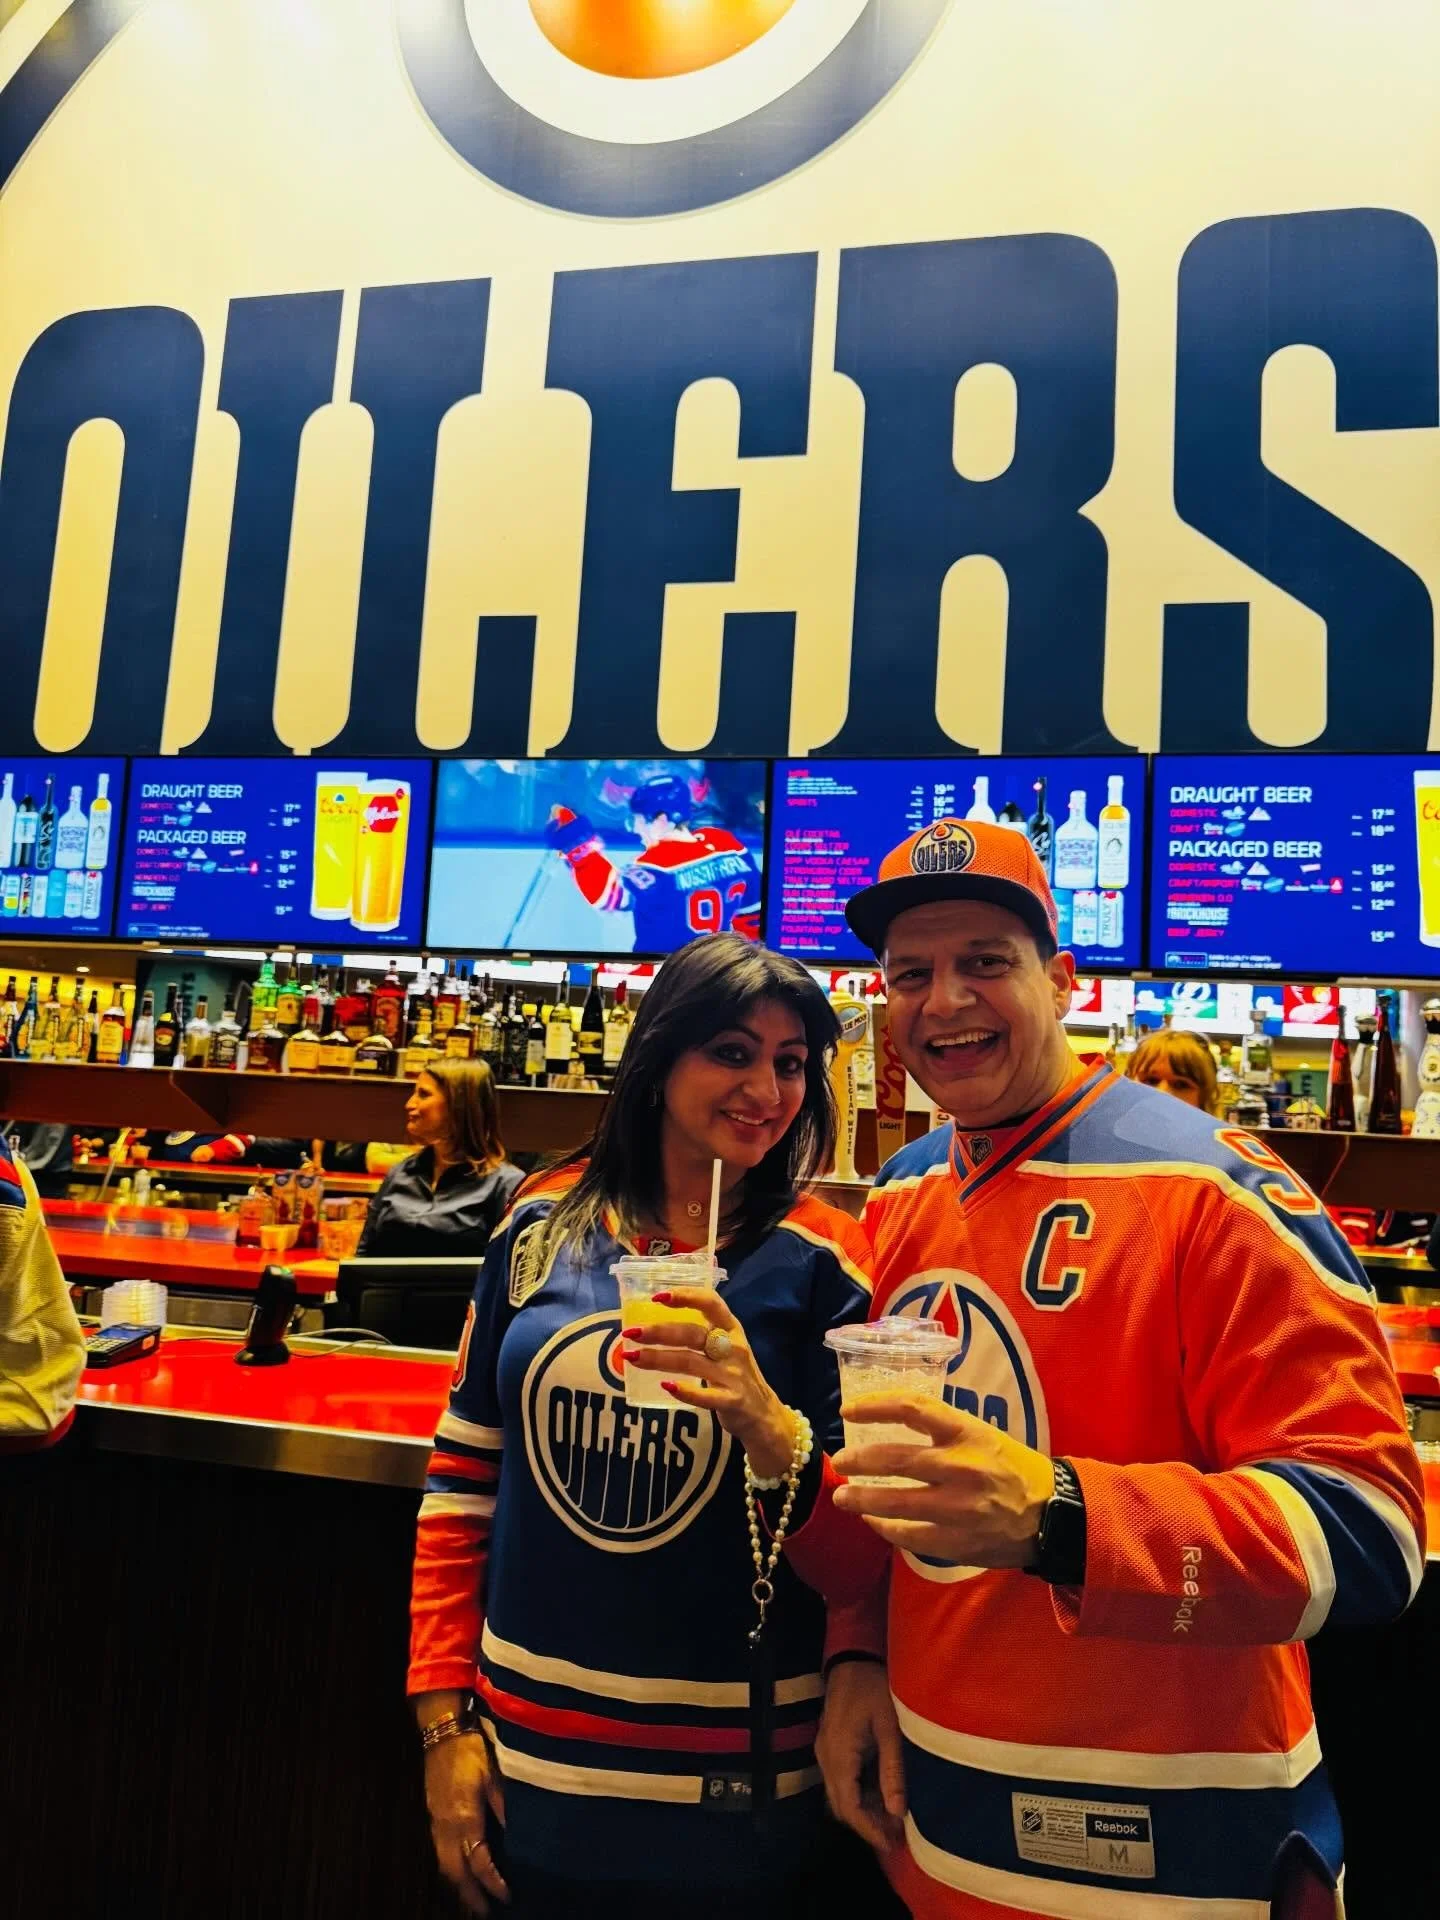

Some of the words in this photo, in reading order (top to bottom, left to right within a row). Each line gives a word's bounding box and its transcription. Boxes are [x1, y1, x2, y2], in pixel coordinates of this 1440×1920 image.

[0, 207, 1440, 755] OILERS
[141, 784, 205, 798] DRAUGHT
[207, 784, 244, 798] BEER
[1170, 786, 1259, 803] DRAUGHT
[1263, 786, 1312, 803] BEER
[1170, 808, 1218, 818] DOMESTIC
[137, 830, 208, 844] PACKAGED
[210, 830, 247, 844] BEER
[916, 840, 968, 871] OILERS
[1168, 840, 1269, 858] PACKAGED
[1272, 840, 1322, 858] BEER
[1168, 863, 1216, 872] DOMESTIC
[846, 1066, 854, 1116] BELGIAN
[880, 1122, 902, 1131] LIGHT
[846, 1120, 854, 1155] WHITE
[1020, 1198, 1097, 1312] C
[547, 1385, 700, 1512] OILERS
[1172, 1545, 1203, 1633] Reebok
[1094, 1820, 1140, 1836] Reebok
[1108, 1843, 1130, 1865] M
